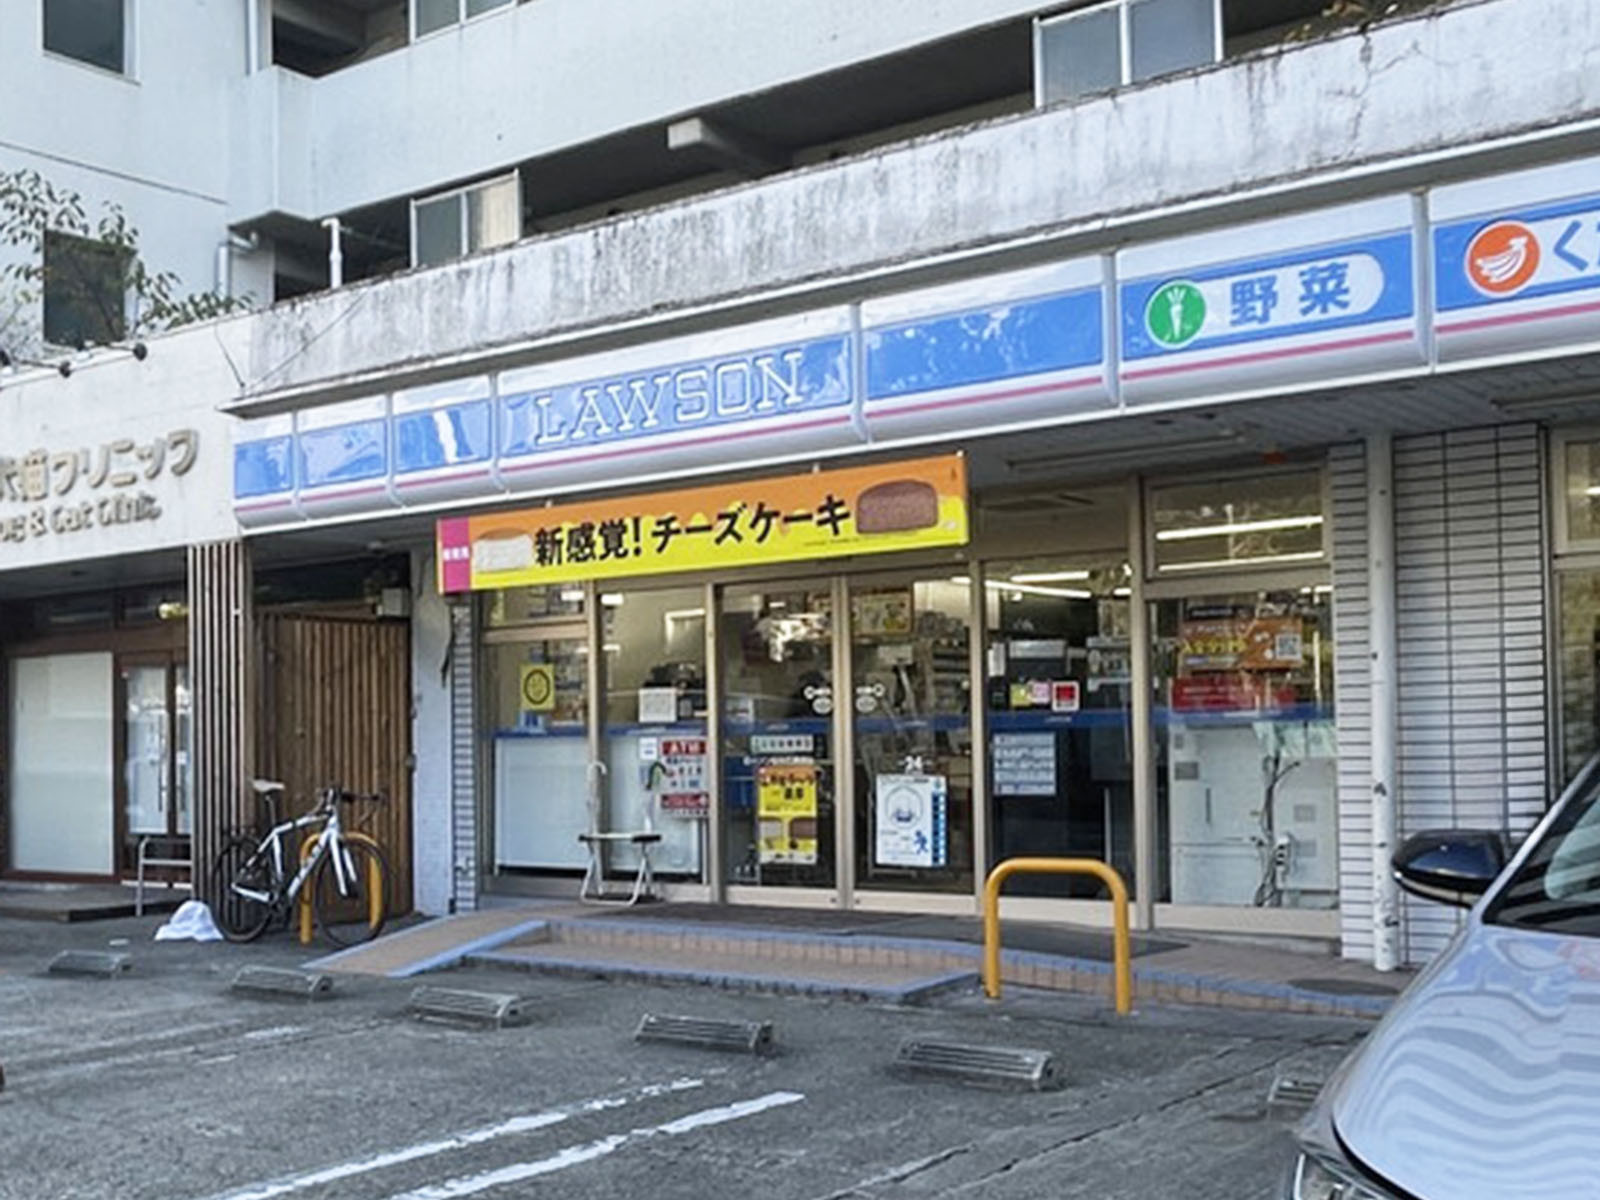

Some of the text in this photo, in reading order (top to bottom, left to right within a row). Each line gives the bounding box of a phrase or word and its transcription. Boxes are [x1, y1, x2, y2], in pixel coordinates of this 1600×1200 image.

[1554, 220, 1600, 271] く
[1230, 262, 1350, 326] 野菜
[535, 351, 804, 444] LAWSON
